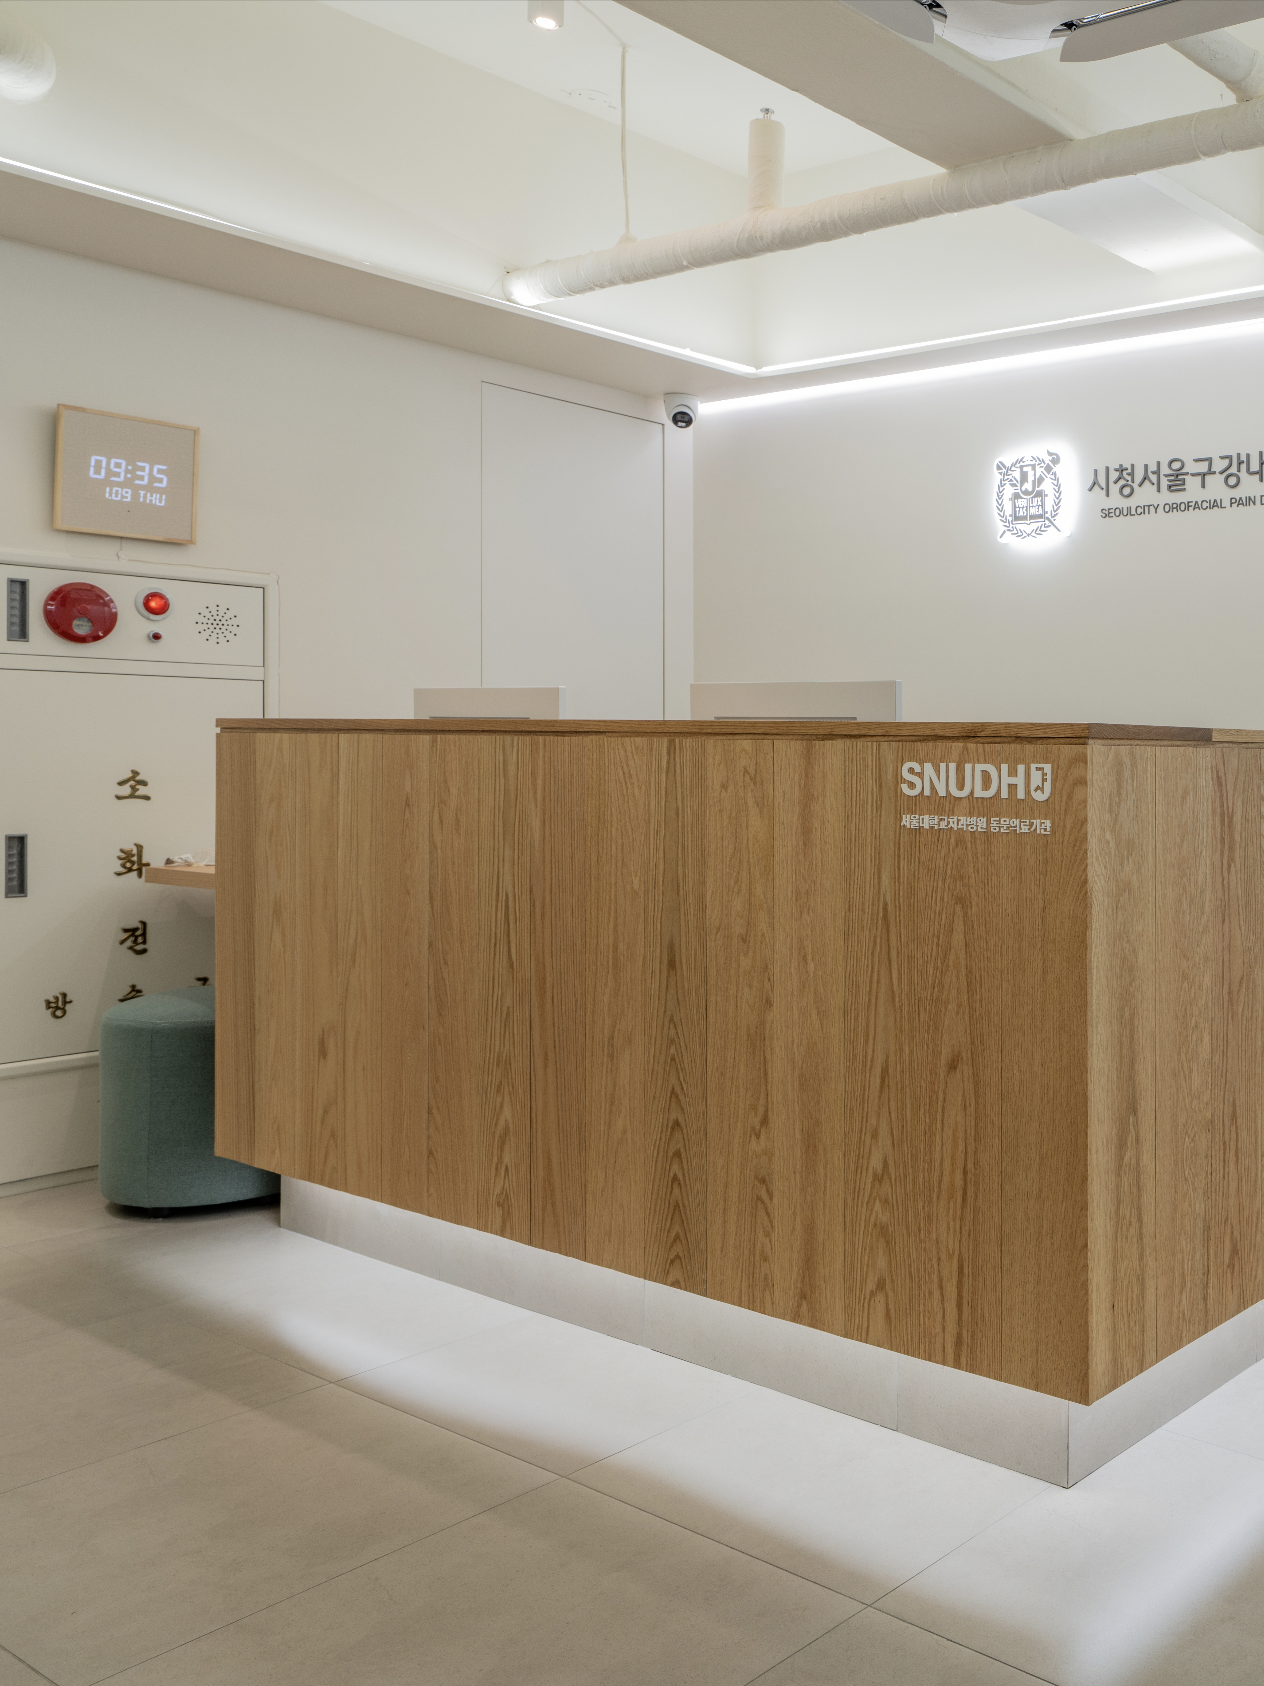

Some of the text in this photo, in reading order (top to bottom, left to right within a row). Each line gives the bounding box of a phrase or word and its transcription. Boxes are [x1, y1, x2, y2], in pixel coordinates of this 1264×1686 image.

[89, 455, 168, 488] 09:35
[138, 490, 166, 507] THU
[1030, 497, 1042, 506] LUX
[1100, 503, 1160, 518] SEOULCITY
[1163, 498, 1227, 514] OROFACIAL
[1229, 494, 1257, 508] PAIN
[1016, 506, 1043, 517] TAS MEA
[900, 761, 1026, 800] SNUDH
[901, 814, 1051, 834] 서울대학교치과병원 동문의료기관
[114, 769, 151, 955] 소화전
